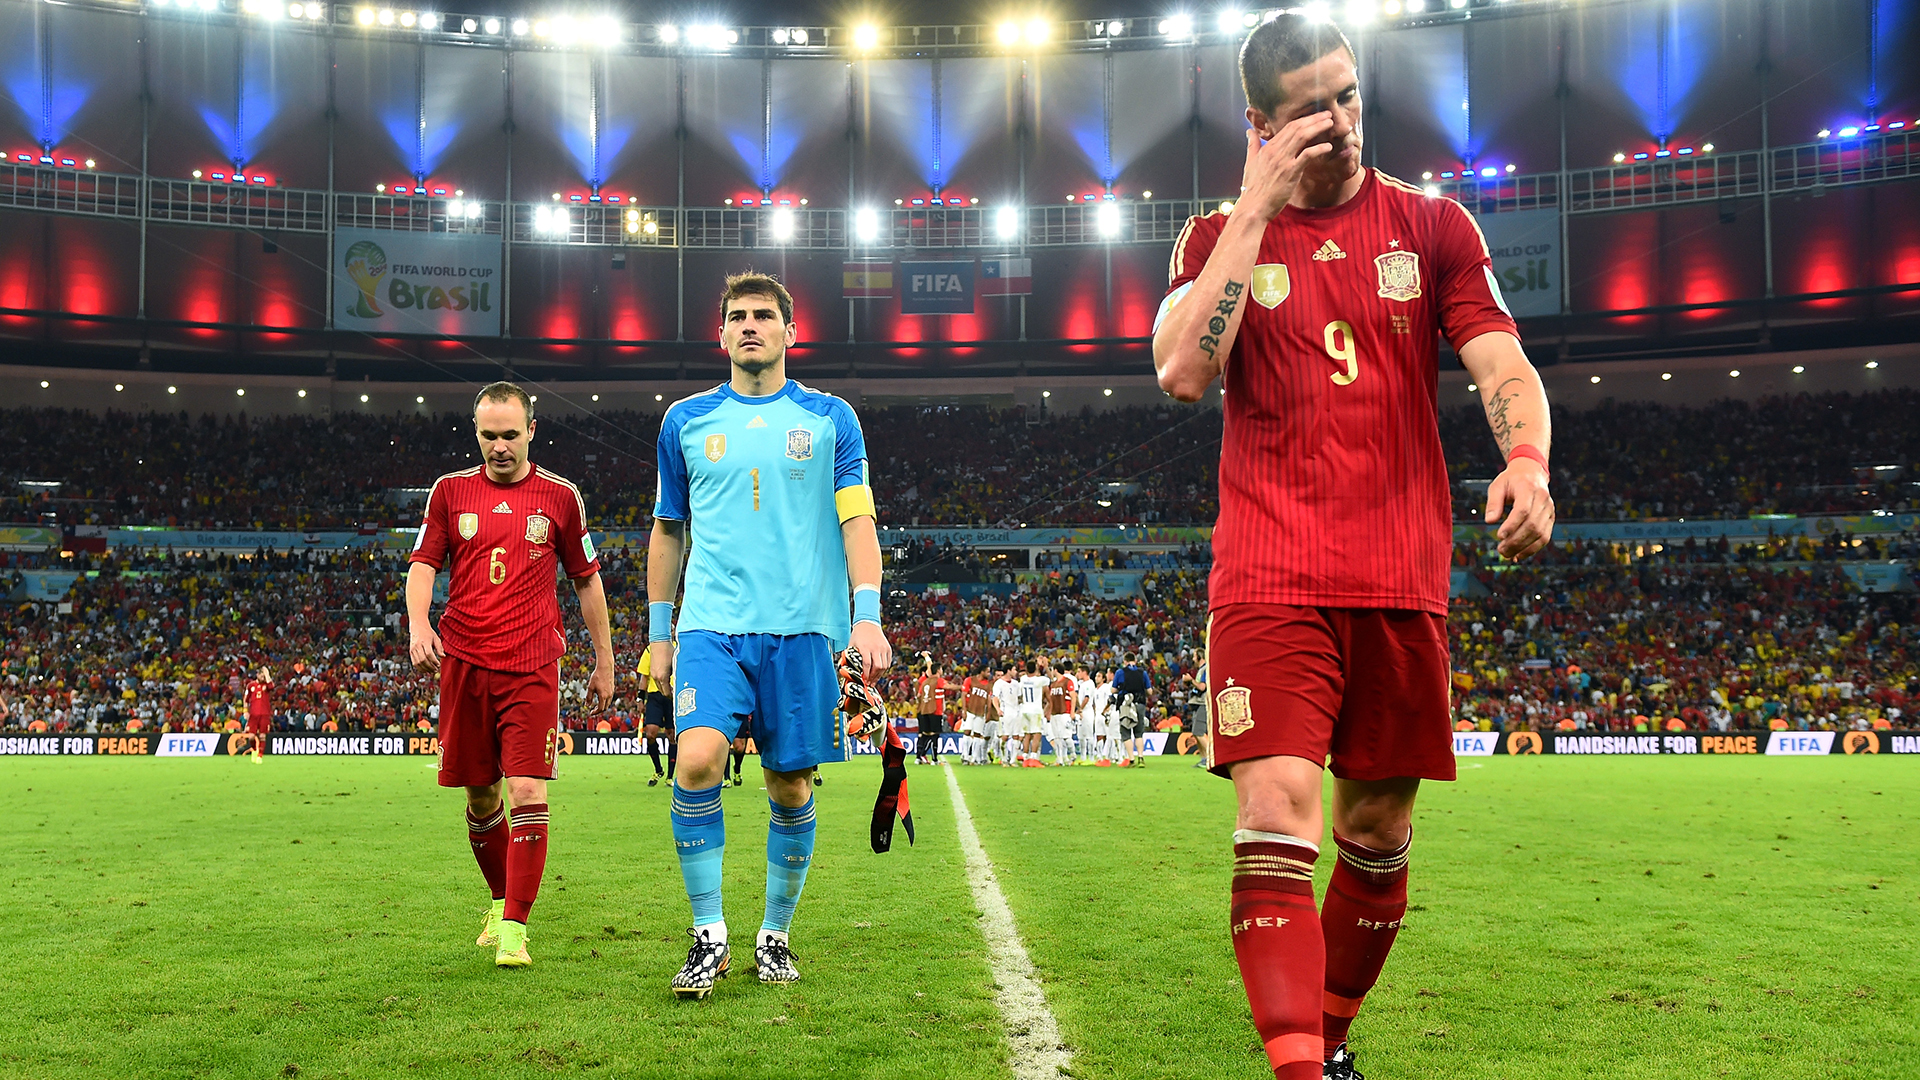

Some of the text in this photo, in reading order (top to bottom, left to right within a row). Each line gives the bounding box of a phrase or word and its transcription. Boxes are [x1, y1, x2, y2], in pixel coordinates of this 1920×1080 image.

[1312, 250, 1347, 262] adidas
[1490, 244, 1552, 258] ORLD CUP
[392, 264, 493, 278] FIFA WORLD CUP
[1493, 258, 1551, 293] sil
[912, 274, 963, 292] FIFA
[388, 278, 491, 313] Brasil
[1323, 320, 1359, 386] 9
[749, 468, 760, 511] 1
[197, 533, 278, 545] Rio de Janeiro
[977, 532, 1010, 542] Brazil
[489, 547, 507, 585] 6
[972, 687, 988, 699] FIFA
[1024, 687, 1034, 702] 11
[63, 738, 94, 754] FOR
[97, 738, 148, 754] PEACE
[168, 739, 207, 752] FIFA
[272, 737, 438, 754] HANDSHAKE FOR PEA
[544, 727, 556, 765] 6
[1456, 738, 1486, 751] IFA
[1555, 736, 1757, 754] HANDSHAKE FOR PEACE
[1779, 738, 1821, 751] FIFA
[1233, 917, 1290, 935] RFEF
